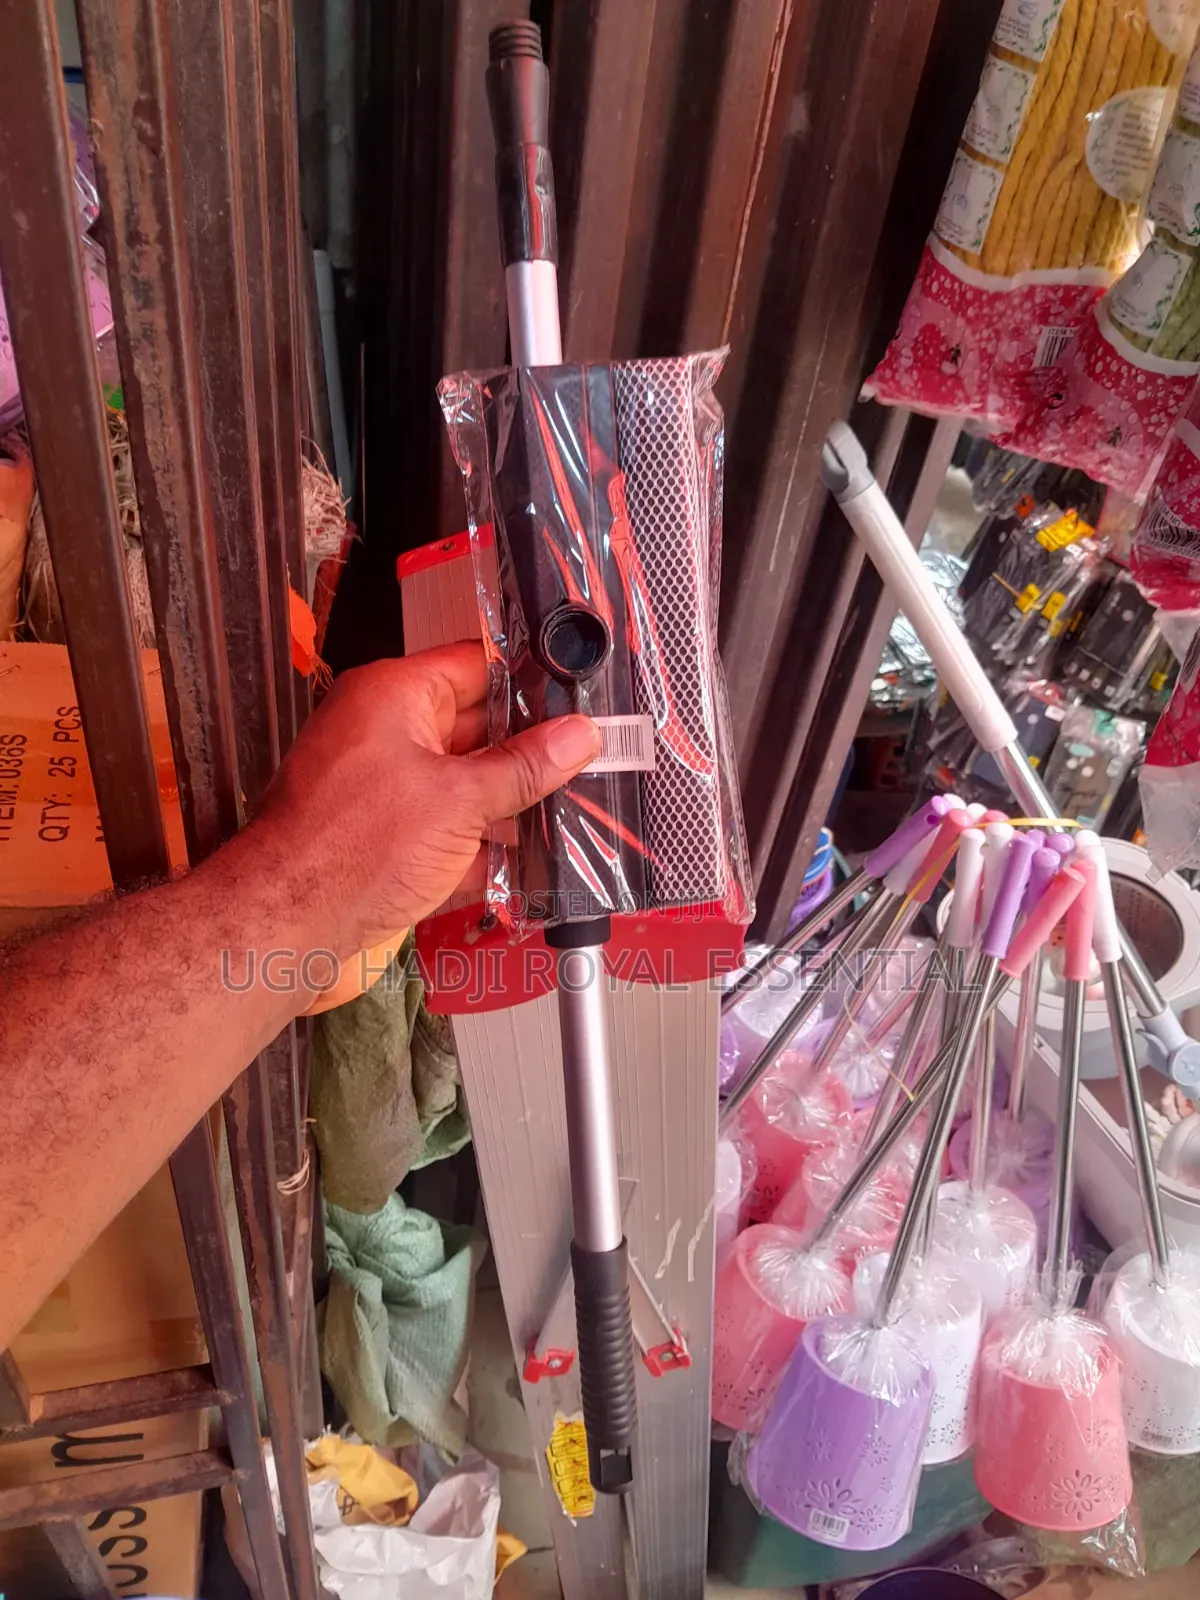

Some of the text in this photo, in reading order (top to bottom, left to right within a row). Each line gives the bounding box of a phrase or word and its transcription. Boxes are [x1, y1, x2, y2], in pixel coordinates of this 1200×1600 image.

[38, 705, 82, 842] QTY: 25 PCS
